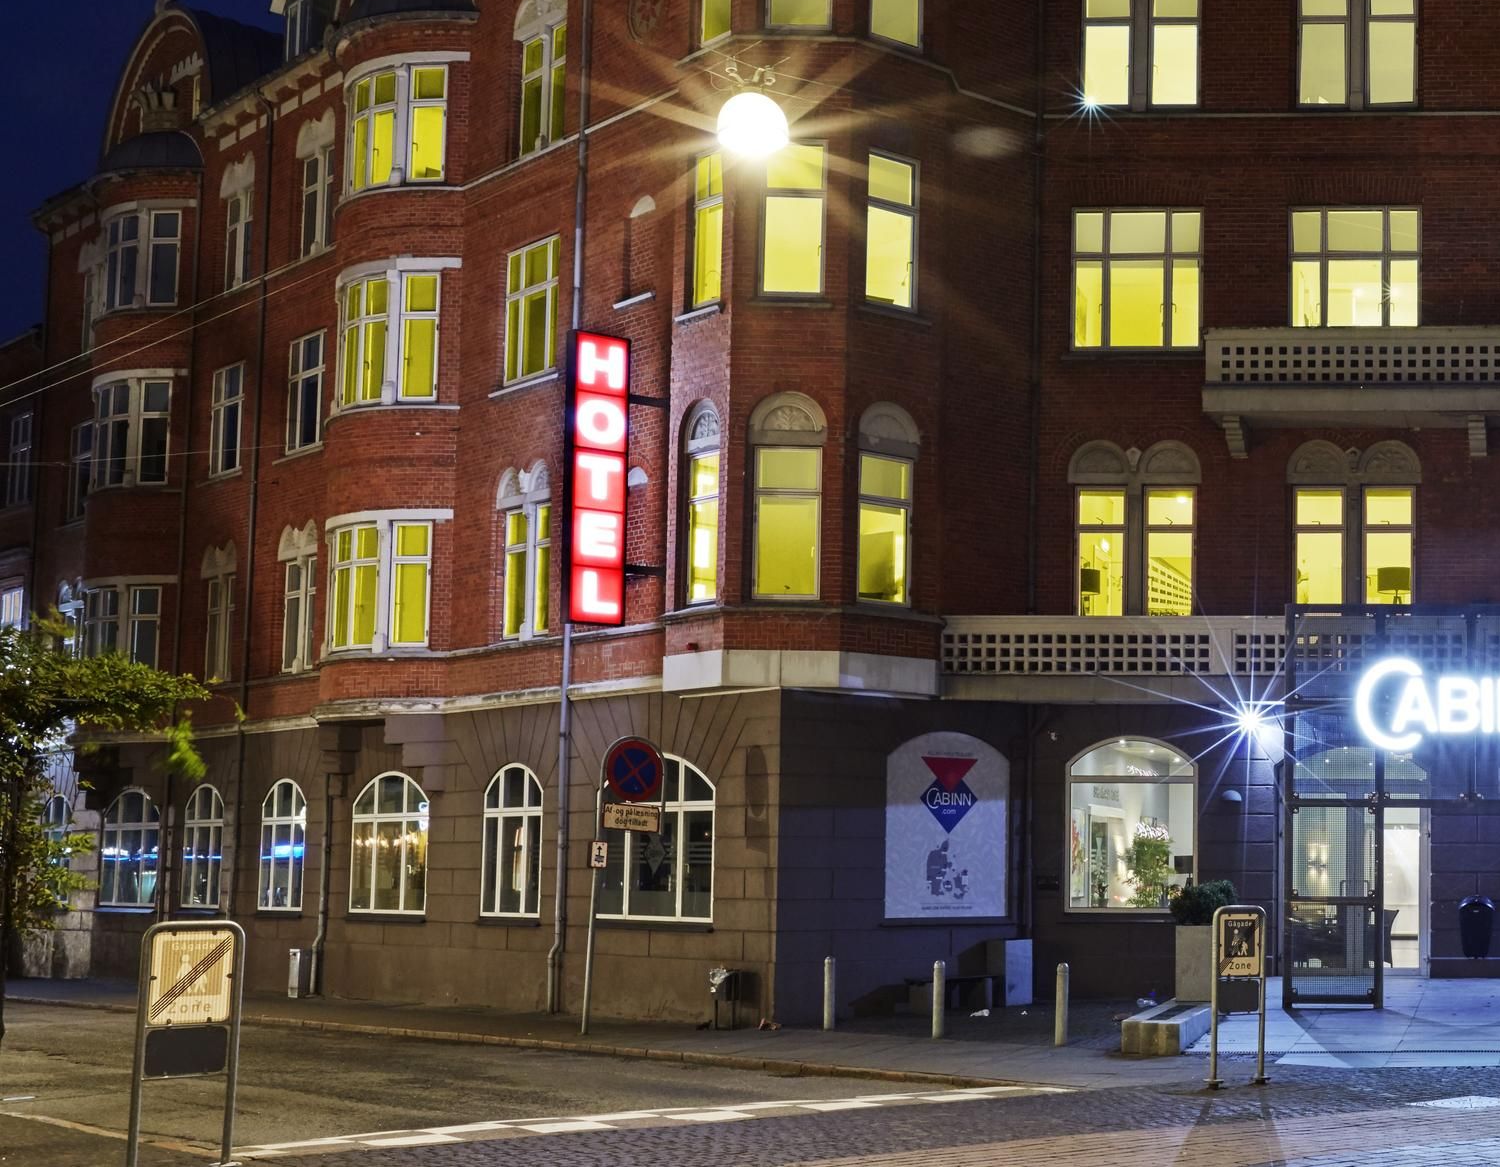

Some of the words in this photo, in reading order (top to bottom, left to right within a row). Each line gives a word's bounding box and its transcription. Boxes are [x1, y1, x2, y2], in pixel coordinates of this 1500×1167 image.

[576, 341, 626, 615] HOTEL
[926, 787, 972, 810] CABINN
[1229, 961, 1252, 970] Zone
[168, 1001, 212, 1014] Zone
